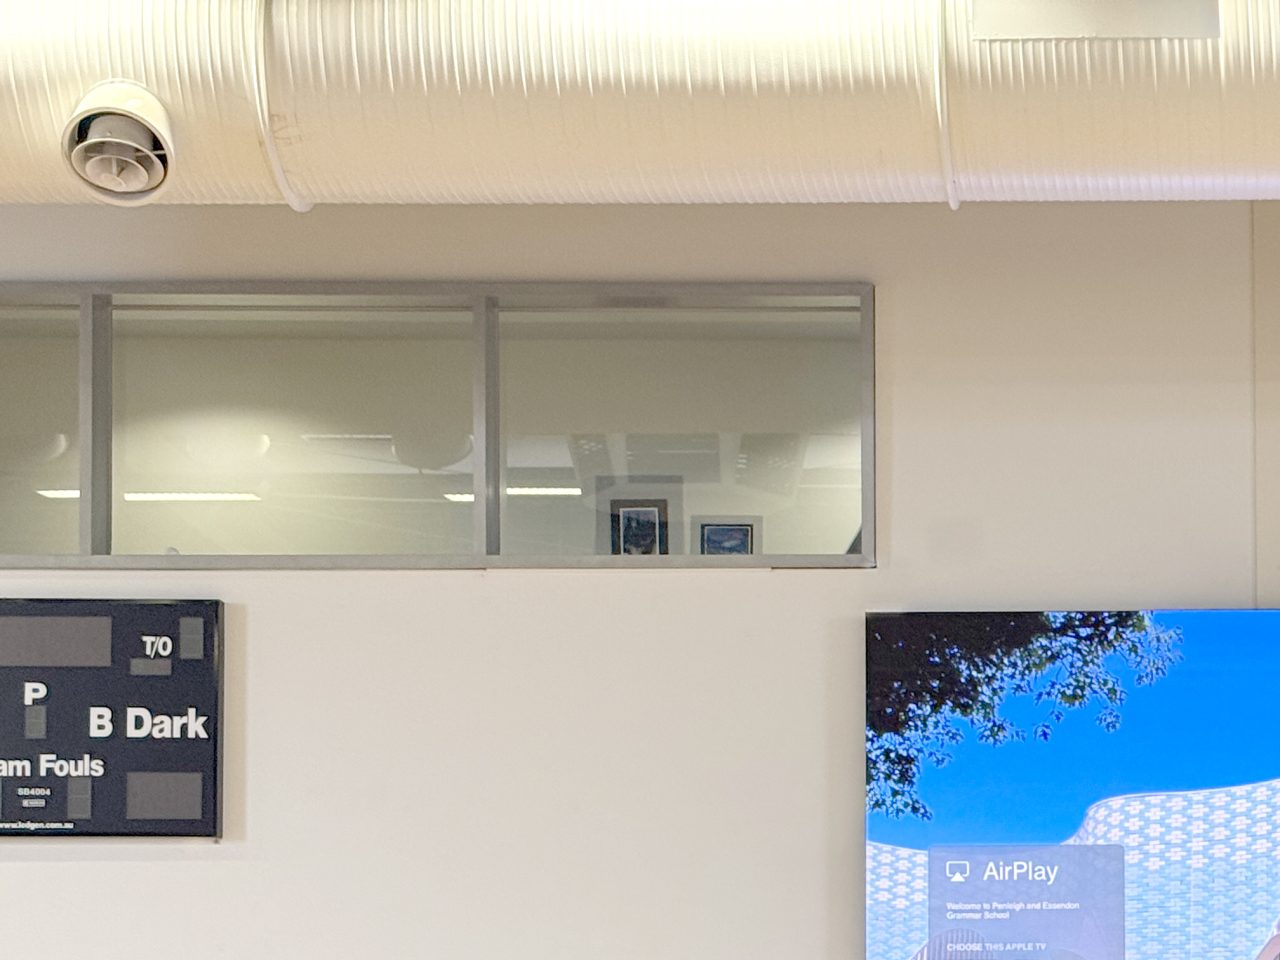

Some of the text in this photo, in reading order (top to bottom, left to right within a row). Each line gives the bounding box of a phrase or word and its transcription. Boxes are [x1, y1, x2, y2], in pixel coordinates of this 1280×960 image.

[141, 635, 173, 658] T/O
[24, 682, 47, 705] P
[89, 707, 208, 739] B Dark
[40, 753, 105, 777] Fouls
[983, 861, 1059, 885] AirPlay
[946, 902, 981, 910] Welcome
[983, 902, 990, 910] to
[1026, 902, 1041, 910] and
[1042, 901, 1080, 910] Essendon
[946, 911, 1010, 920] Grammar School
[946, 943, 1047, 951] CHOOSE THIS APPLE TV
